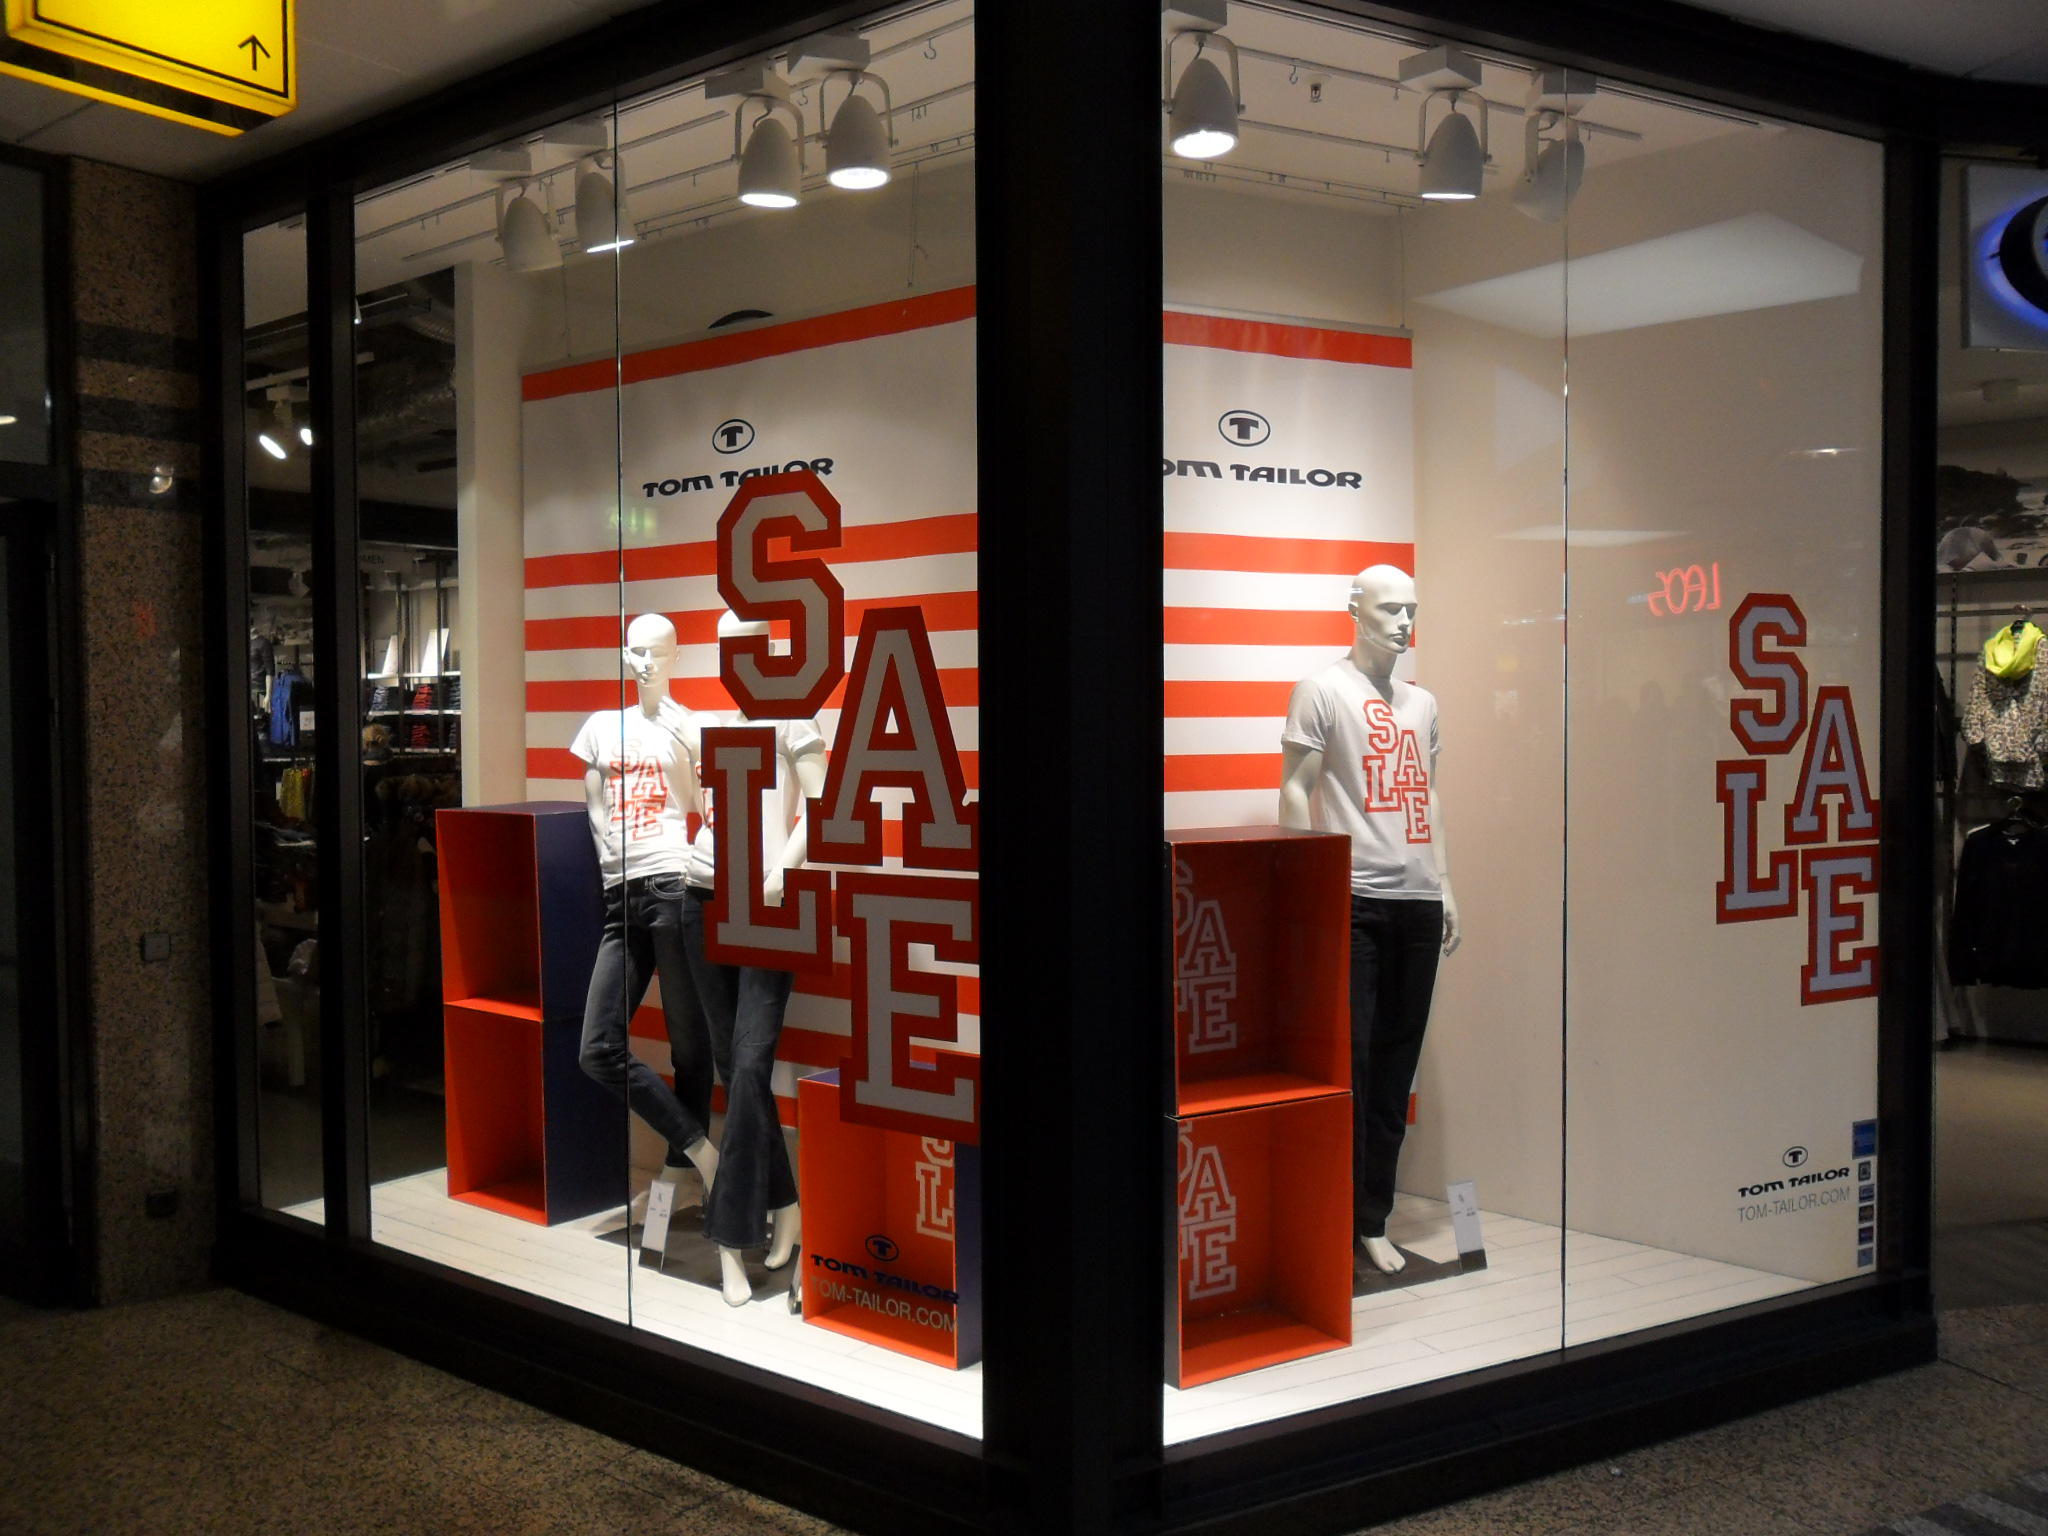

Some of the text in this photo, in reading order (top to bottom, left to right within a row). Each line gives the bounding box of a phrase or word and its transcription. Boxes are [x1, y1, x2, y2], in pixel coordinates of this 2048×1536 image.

[643, 475, 714, 498] TOM
[1229, 463, 1363, 489] TAILOR
[1738, 1167, 1850, 1198] TOM TAILOR
[1738, 1187, 1850, 1222] TOM-TAILOR.COM
[810, 1253, 960, 1305] TOM TAILOR
